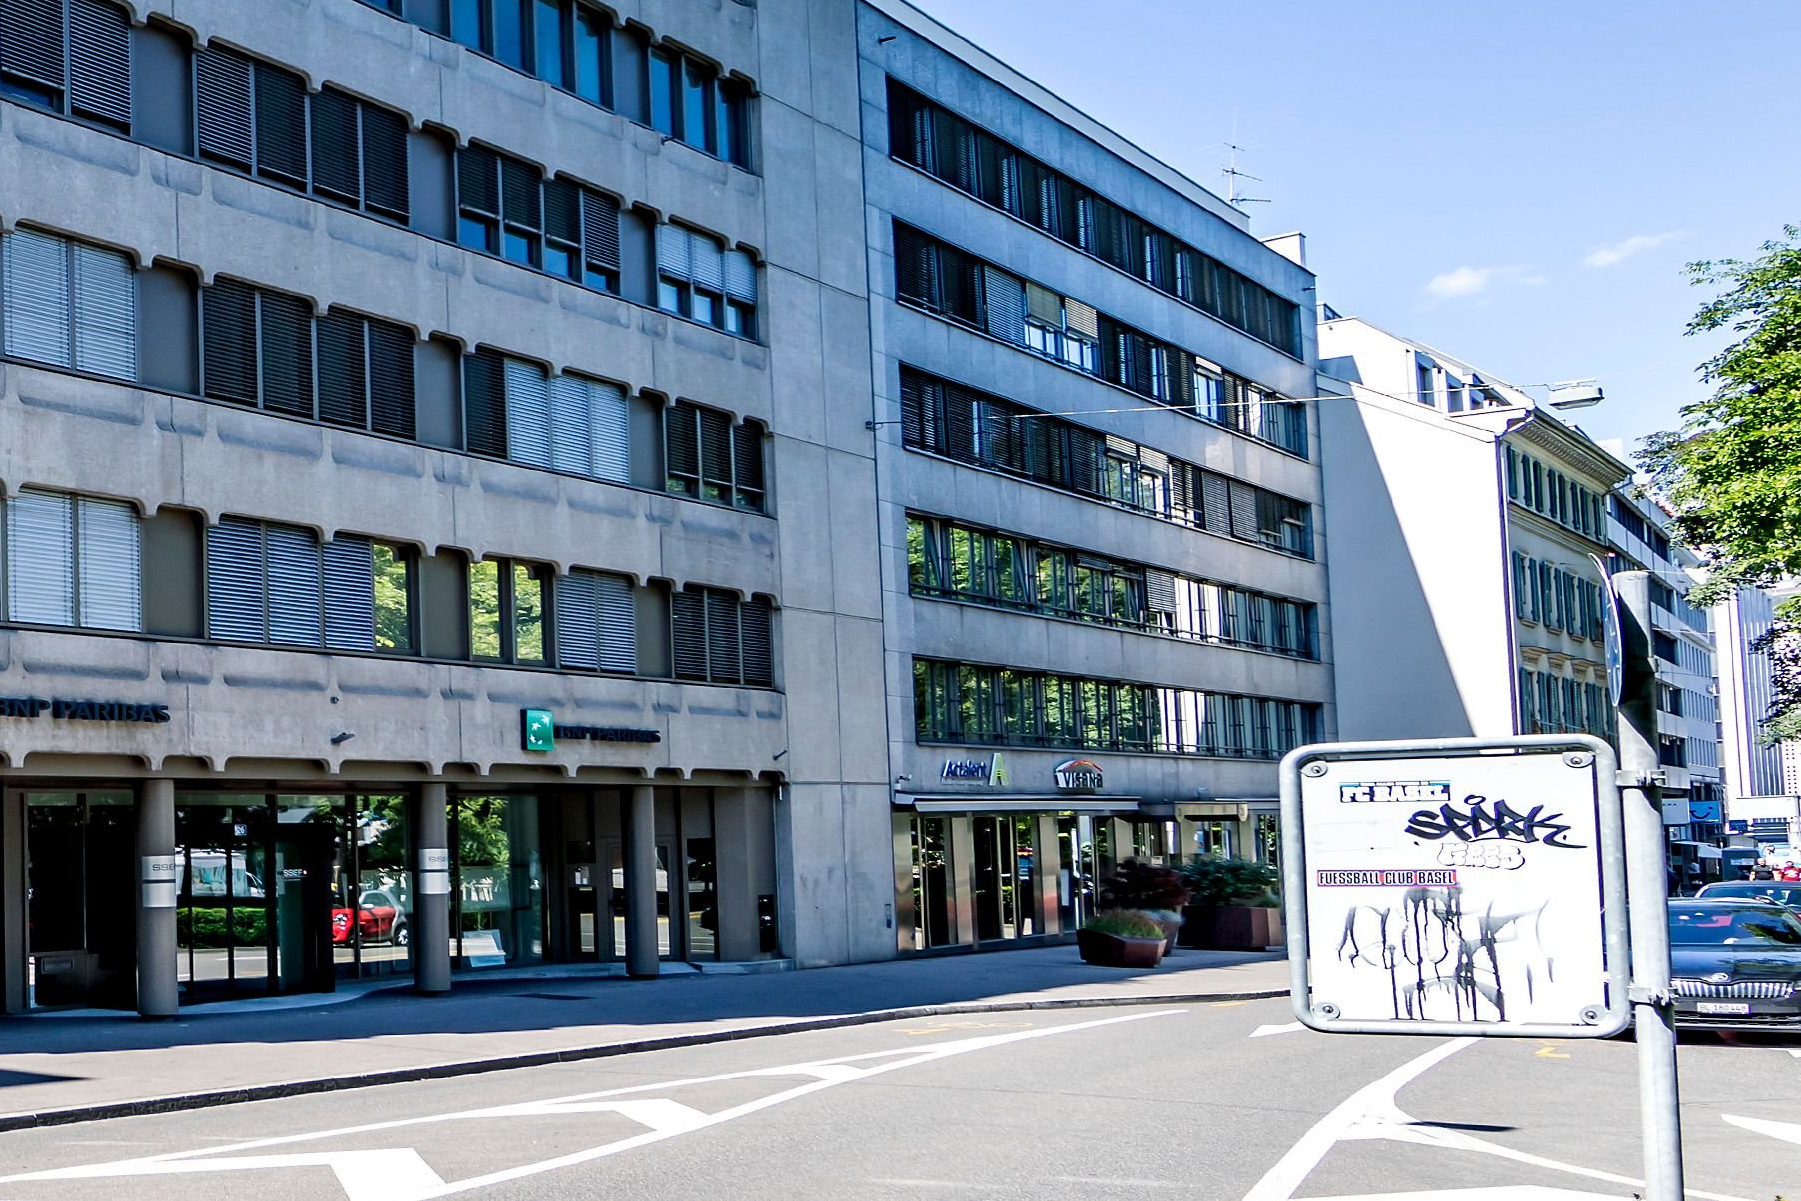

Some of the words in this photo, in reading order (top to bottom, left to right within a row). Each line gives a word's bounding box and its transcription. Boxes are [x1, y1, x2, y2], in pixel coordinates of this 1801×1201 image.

[52, 699, 171, 723] PARIBAS
[554, 725, 593, 740] BNP
[594, 727, 661, 743] PARIBAS
[1319, 871, 1380, 884] FUESSBALL
[1385, 871, 1414, 884] CLUB
[1418, 871, 1453, 884] BASEL
